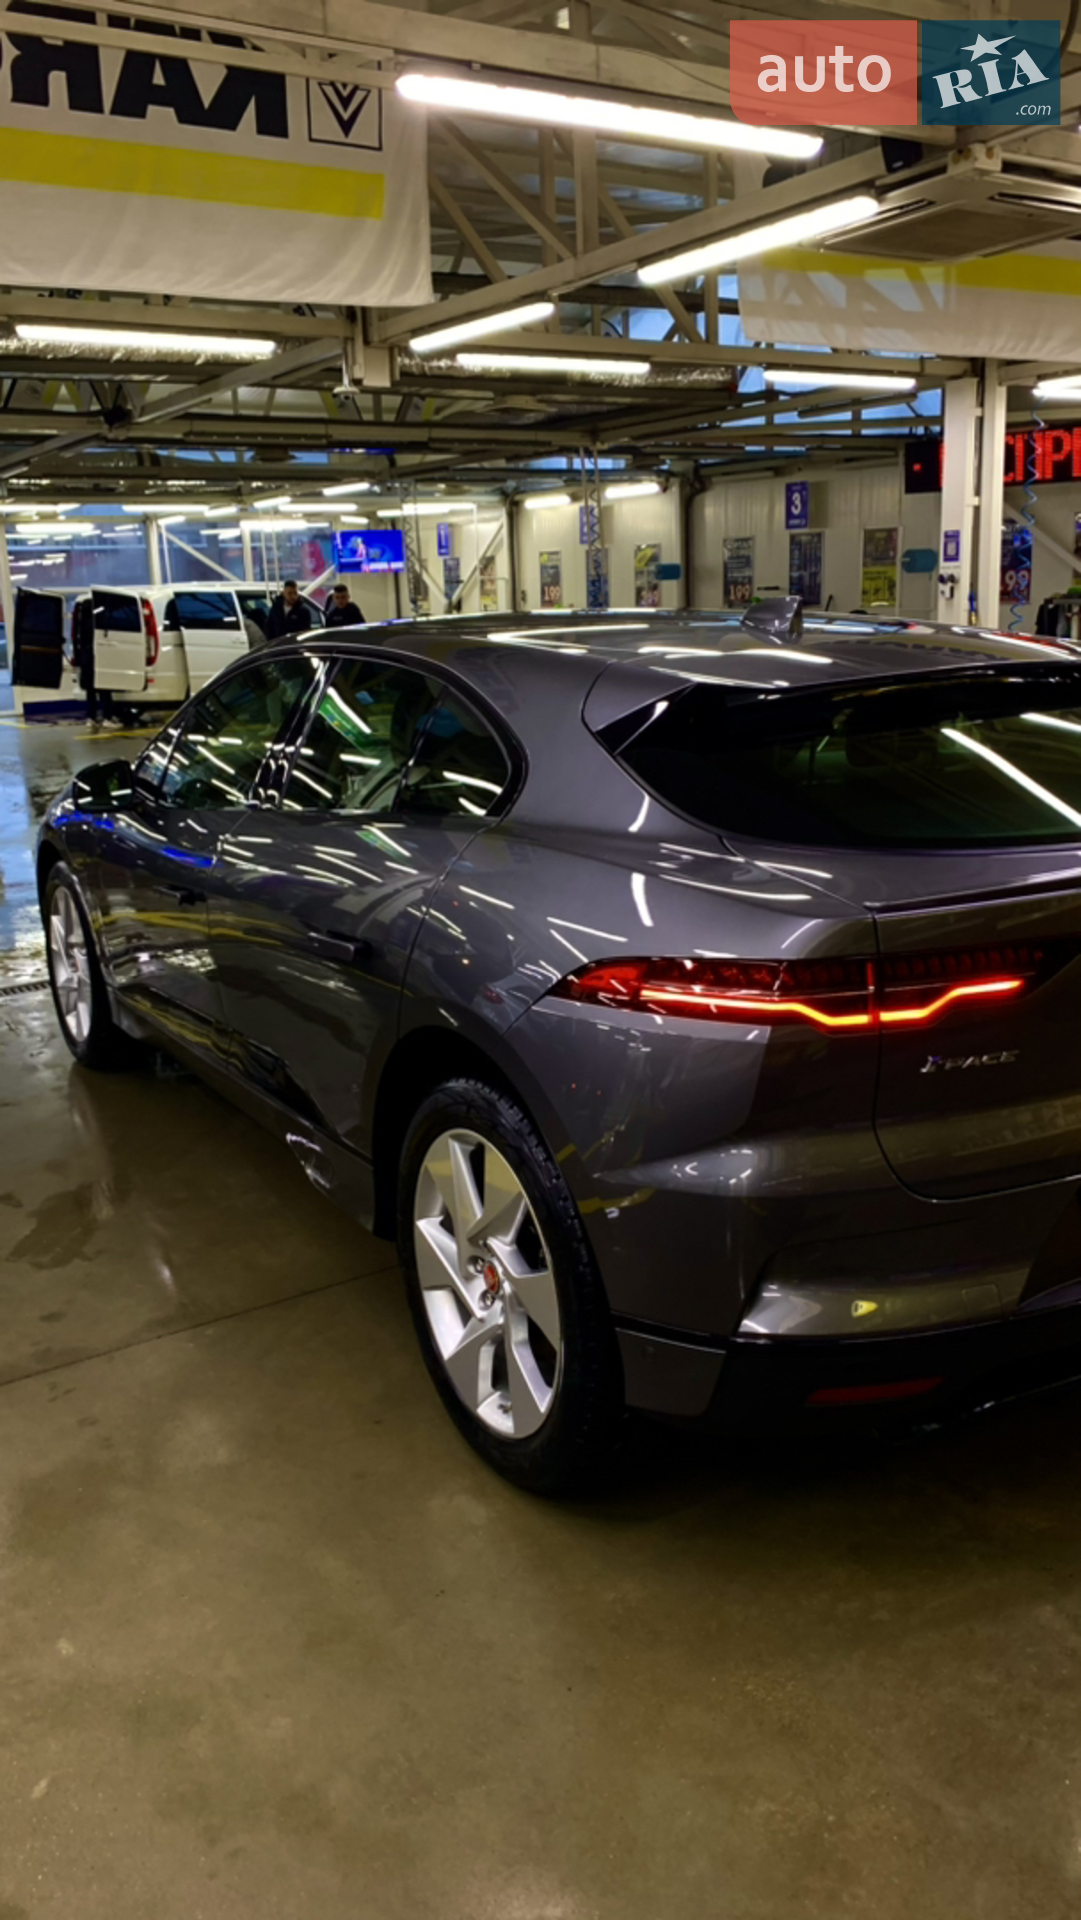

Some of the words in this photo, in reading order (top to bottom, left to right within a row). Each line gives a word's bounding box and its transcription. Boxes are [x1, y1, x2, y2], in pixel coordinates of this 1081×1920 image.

[791, 491, 802, 516] 3
[1000, 570, 1029, 592] 99
[544, 586, 560, 601] 199
[729, 584, 750, 601] 199
